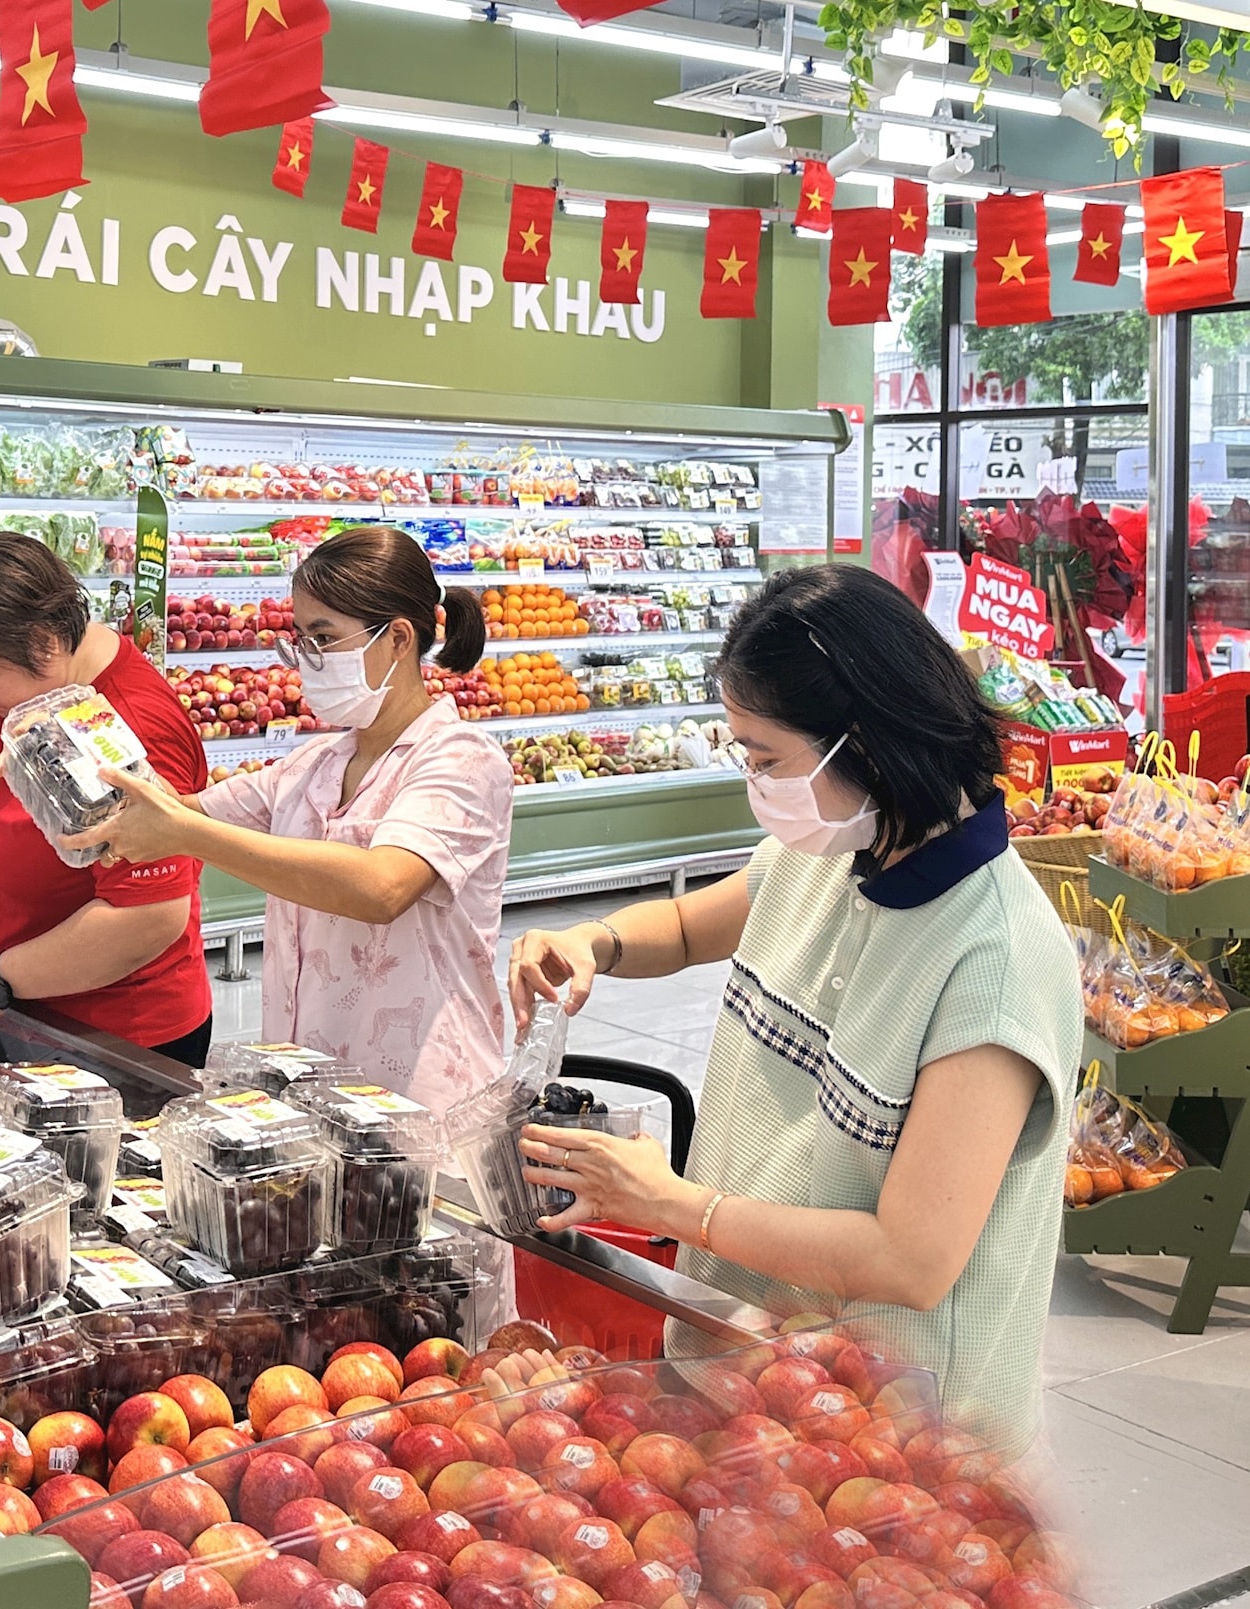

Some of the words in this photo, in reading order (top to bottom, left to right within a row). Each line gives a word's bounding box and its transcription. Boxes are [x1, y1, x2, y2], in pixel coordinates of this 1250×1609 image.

[150, 214, 294, 303] CÂY
[986, 457, 1026, 479] GÀ
[980, 557, 1024, 584] WinMart
[976, 573, 1040, 614] MUA
[968, 592, 1049, 643] NGAY
[273, 729, 287, 741] 79
[1069, 739, 1110, 754] WinMart
[131, 864, 177, 879] MASAN
